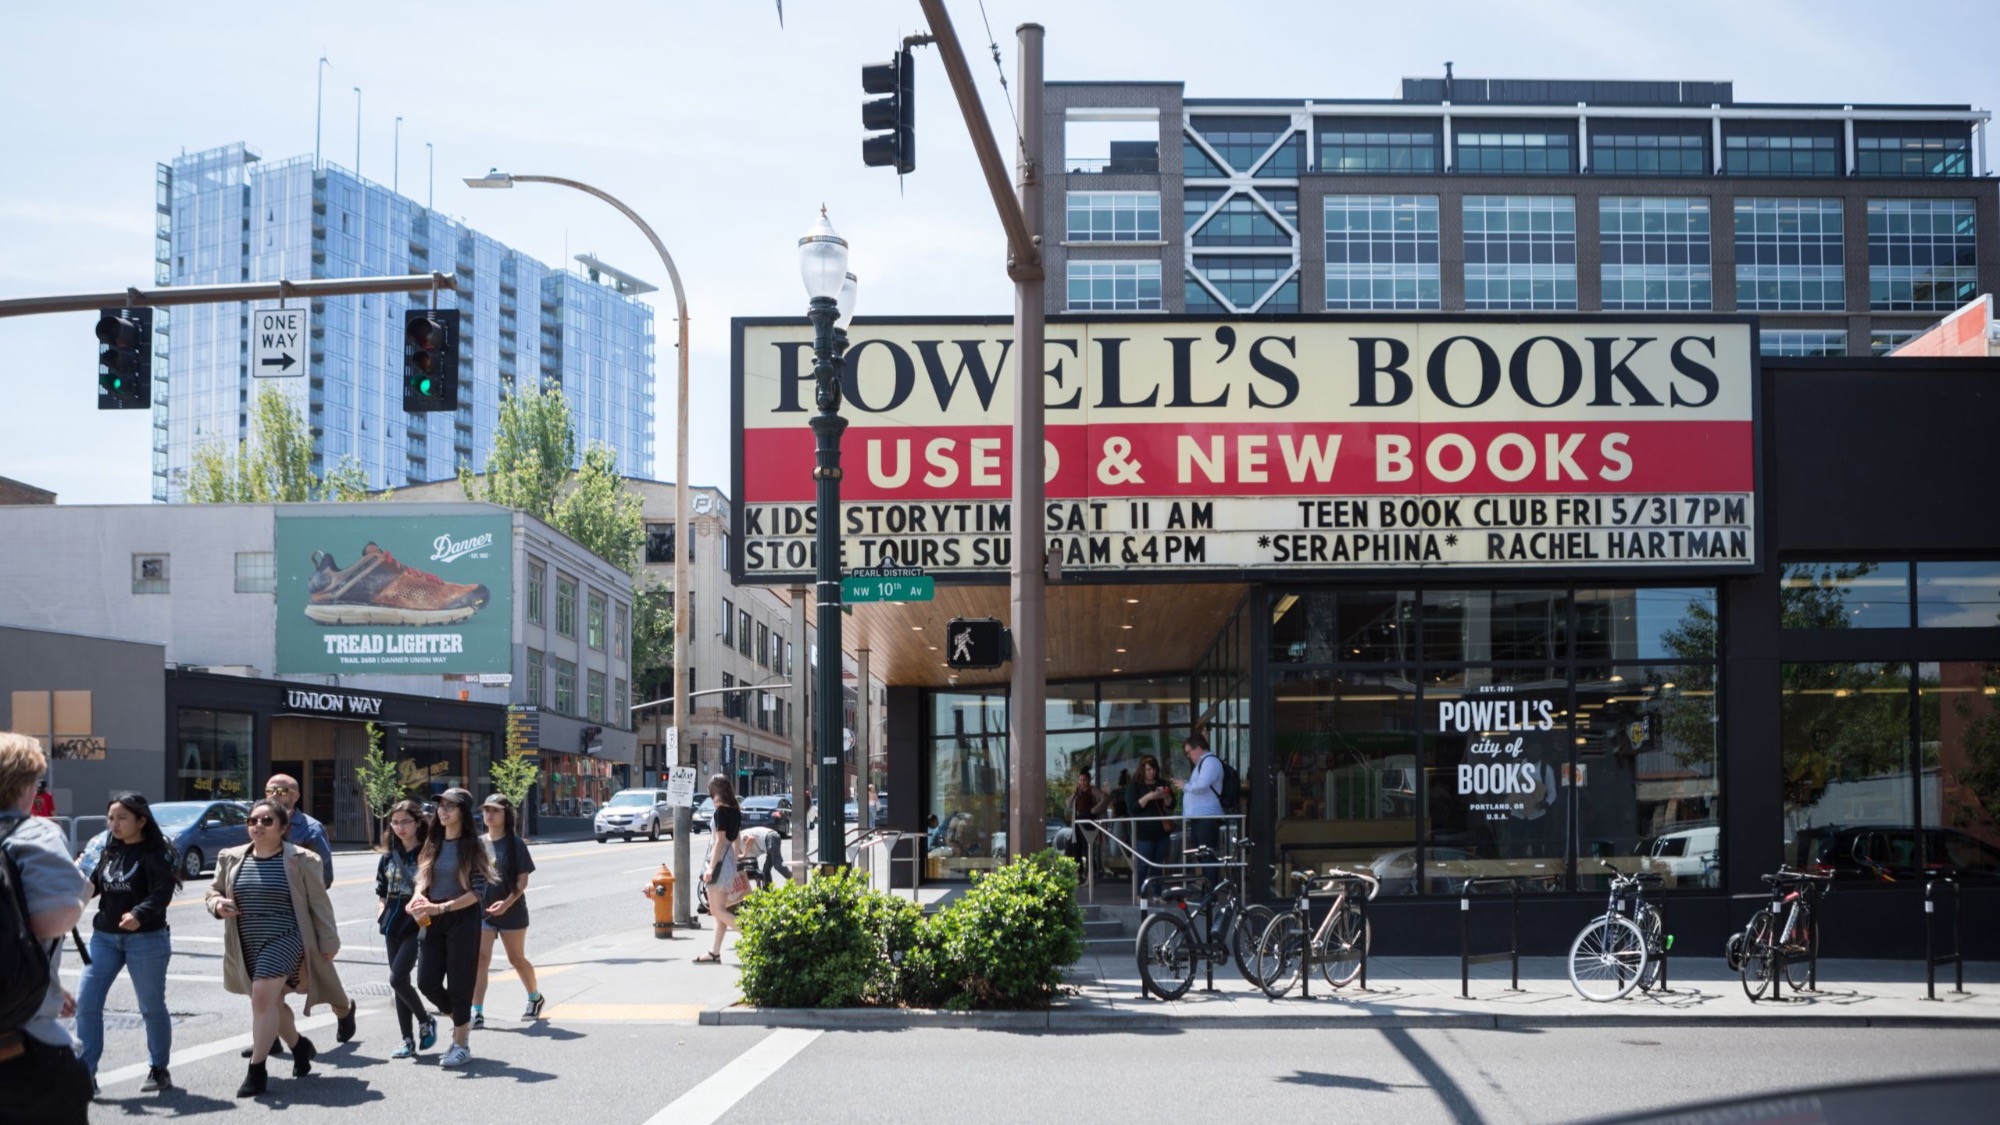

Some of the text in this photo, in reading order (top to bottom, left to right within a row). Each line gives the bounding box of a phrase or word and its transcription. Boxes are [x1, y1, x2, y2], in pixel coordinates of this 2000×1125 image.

[263, 315, 297, 330] ONE
[262, 332, 298, 348] WAY
[771, 325, 1720, 413] POWELL'S BOOKS
[1096, 436, 1146, 485] &
[1177, 434, 1343, 483] NEW
[1375, 432, 1634, 483] BOOKS
[746, 505, 817, 536] KIDS
[846, 504, 1012, 535] STORYTIM
[1046, 503, 1108, 531] SAT
[1167, 501, 1214, 530] AM
[1298, 500, 1369, 529] TEEN
[1380, 499, 1462, 528] BOOK
[1473, 498, 1548, 526] CLUB
[1556, 498, 1602, 526] FRI
[430, 533, 493, 561] Danner
[746, 540, 848, 569] STO
[859, 538, 961, 568] TOURS
[973, 537, 1012, 567] SU
[1487, 531, 1600, 560] RACHEL
[1608, 530, 1748, 559] HARTMAN
[853, 568, 922, 577] PEARL DISTRICT
[853, 582, 923, 597] NW 10th Av
[323, 633, 463, 654] TREAD LIGHTER
[381, 656, 409, 664] DANNER
[465, 674, 479, 683] BIG
[287, 690, 382, 715] UNION WAY
[1439, 699, 1554, 732] POWELL'S
[1470, 736, 1524, 758] city of
[1458, 762, 1537, 794] BOOKS
[1470, 803, 1513, 811] PORTLAND,
